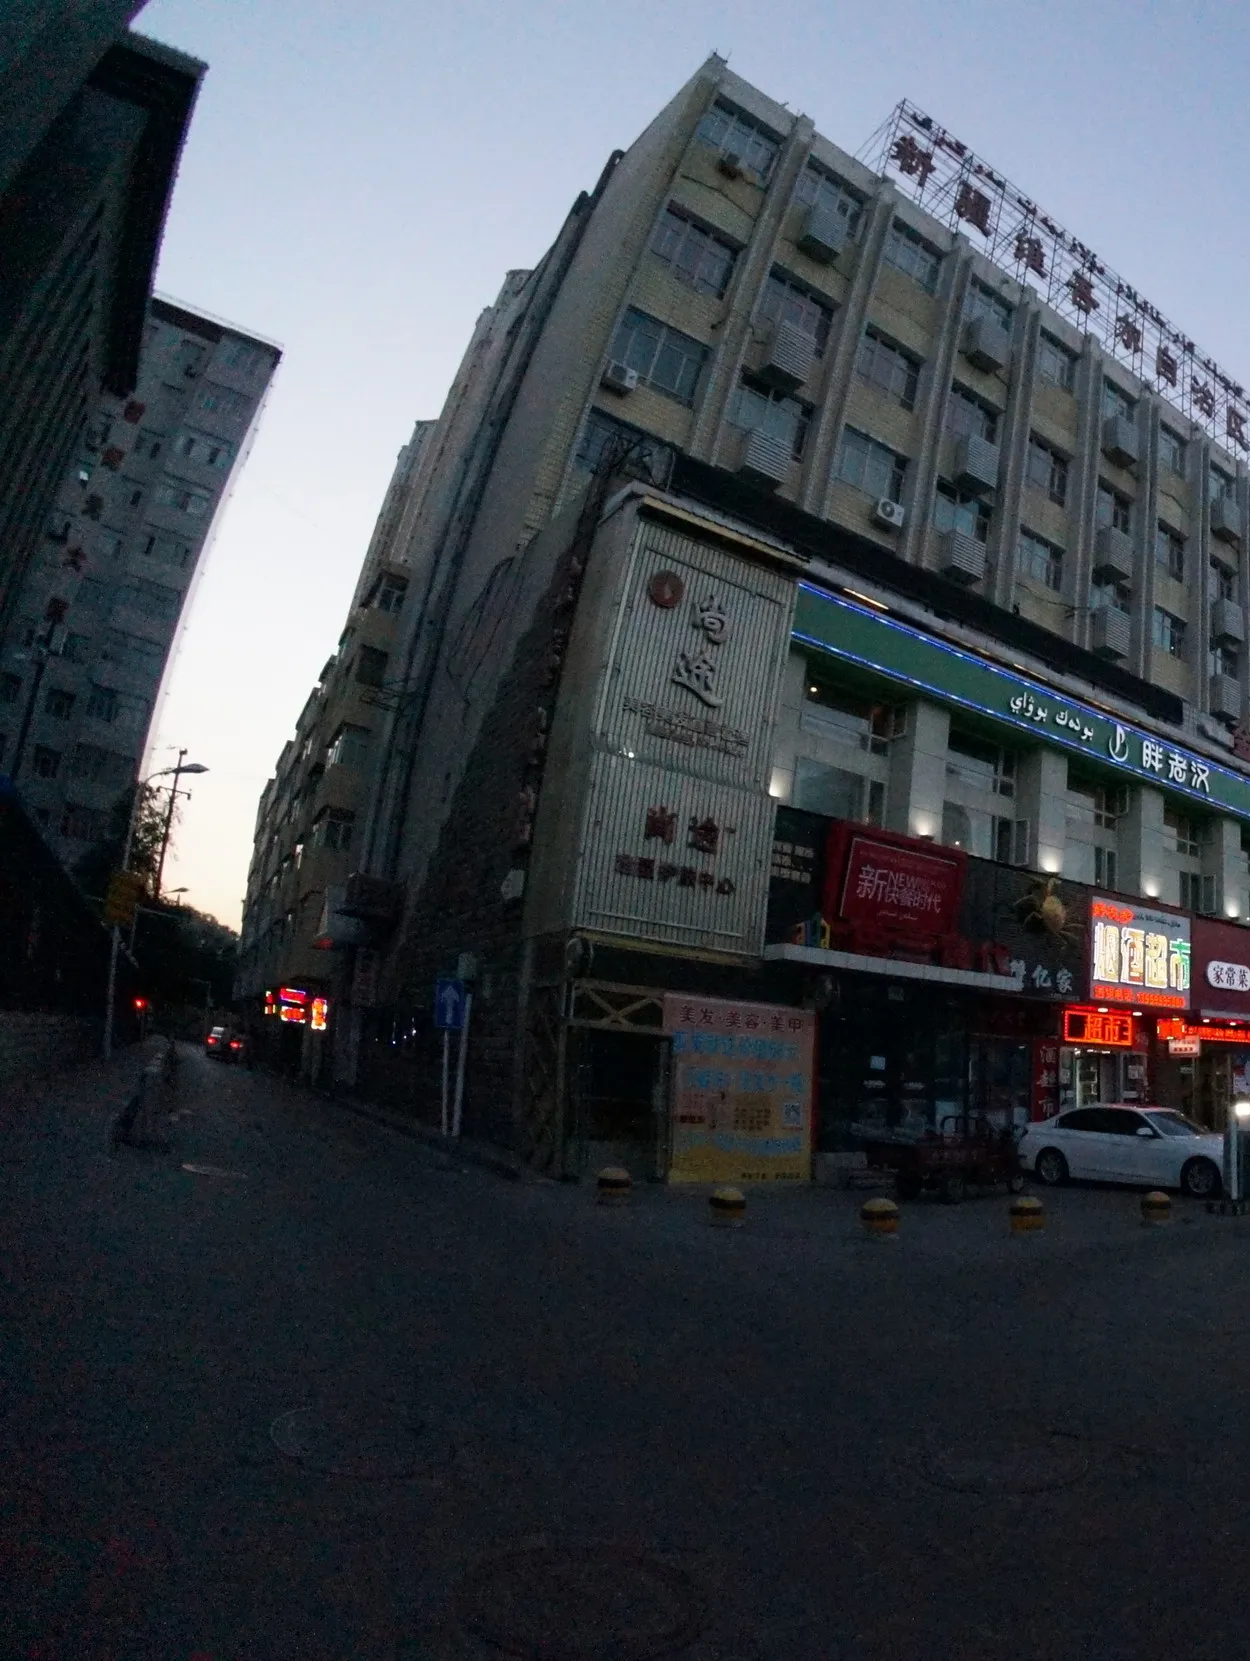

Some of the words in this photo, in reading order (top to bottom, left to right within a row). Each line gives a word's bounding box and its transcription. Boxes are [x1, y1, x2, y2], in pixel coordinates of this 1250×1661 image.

[1140, 740, 1210, 793] 胖老汉
[1093, 922, 1191, 991] 烟酒超市
[1212, 966, 1249, 988] 家常菜
